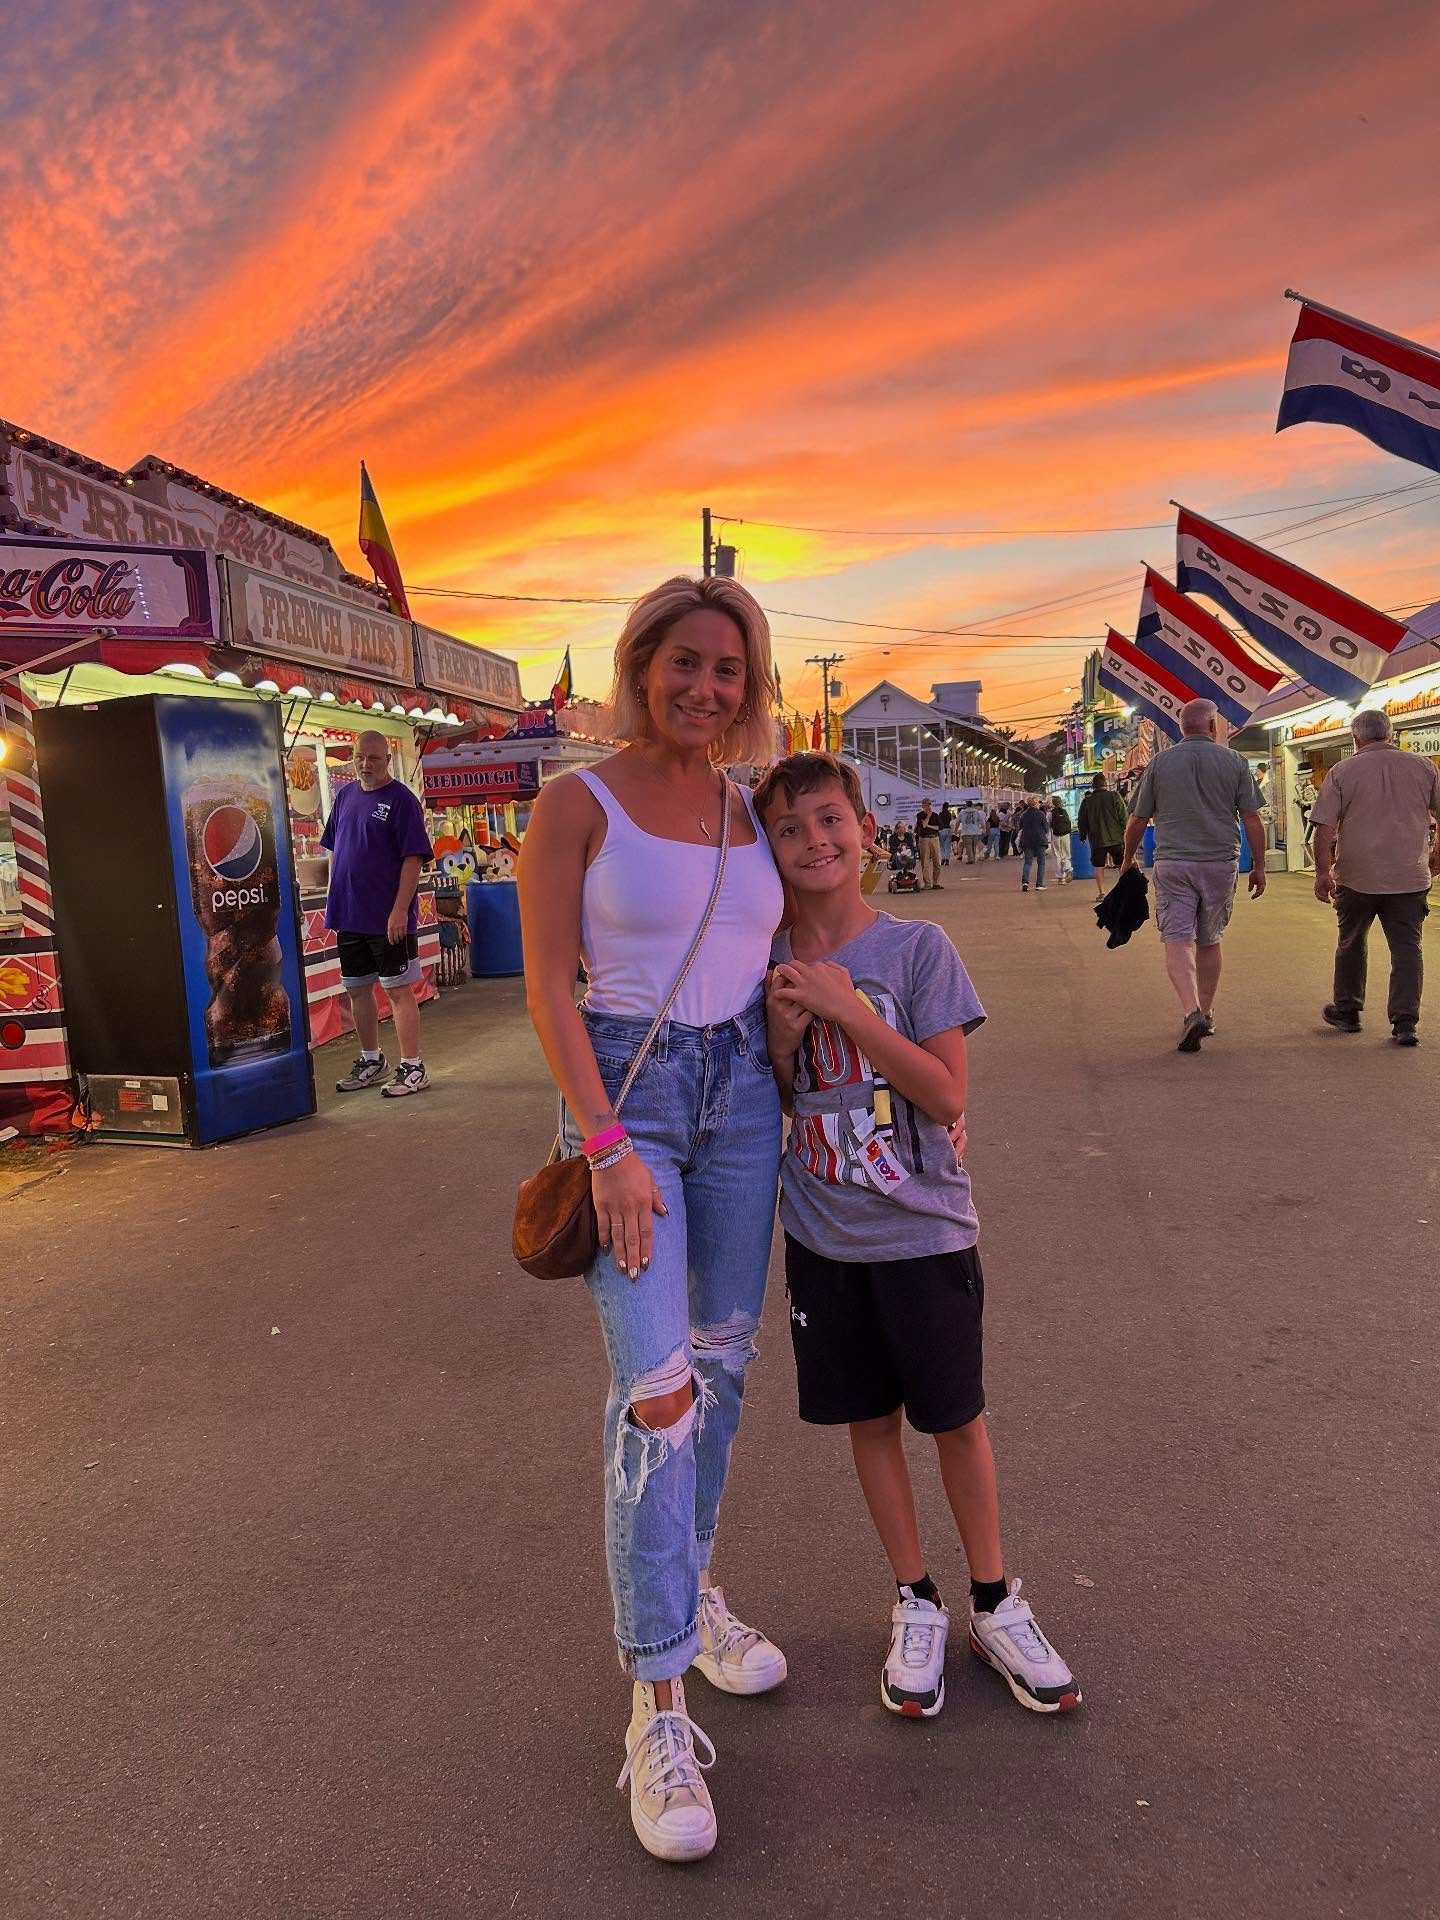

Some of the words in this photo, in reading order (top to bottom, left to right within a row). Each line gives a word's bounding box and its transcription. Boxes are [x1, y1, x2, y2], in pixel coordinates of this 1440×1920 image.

[0, 557, 139, 619] a-Cola
[259, 584, 344, 656] FRENCH
[347, 611, 397, 670] FRIES
[437, 645, 483, 690] FRENCH
[483, 660, 513, 698] FRIES
[517, 709, 547, 730] DY
[1101, 748, 1126, 762] OR
[424, 773, 462, 790] RIED
[464, 769, 516, 787] DOUGH
[211, 883, 265, 912] pepsi
